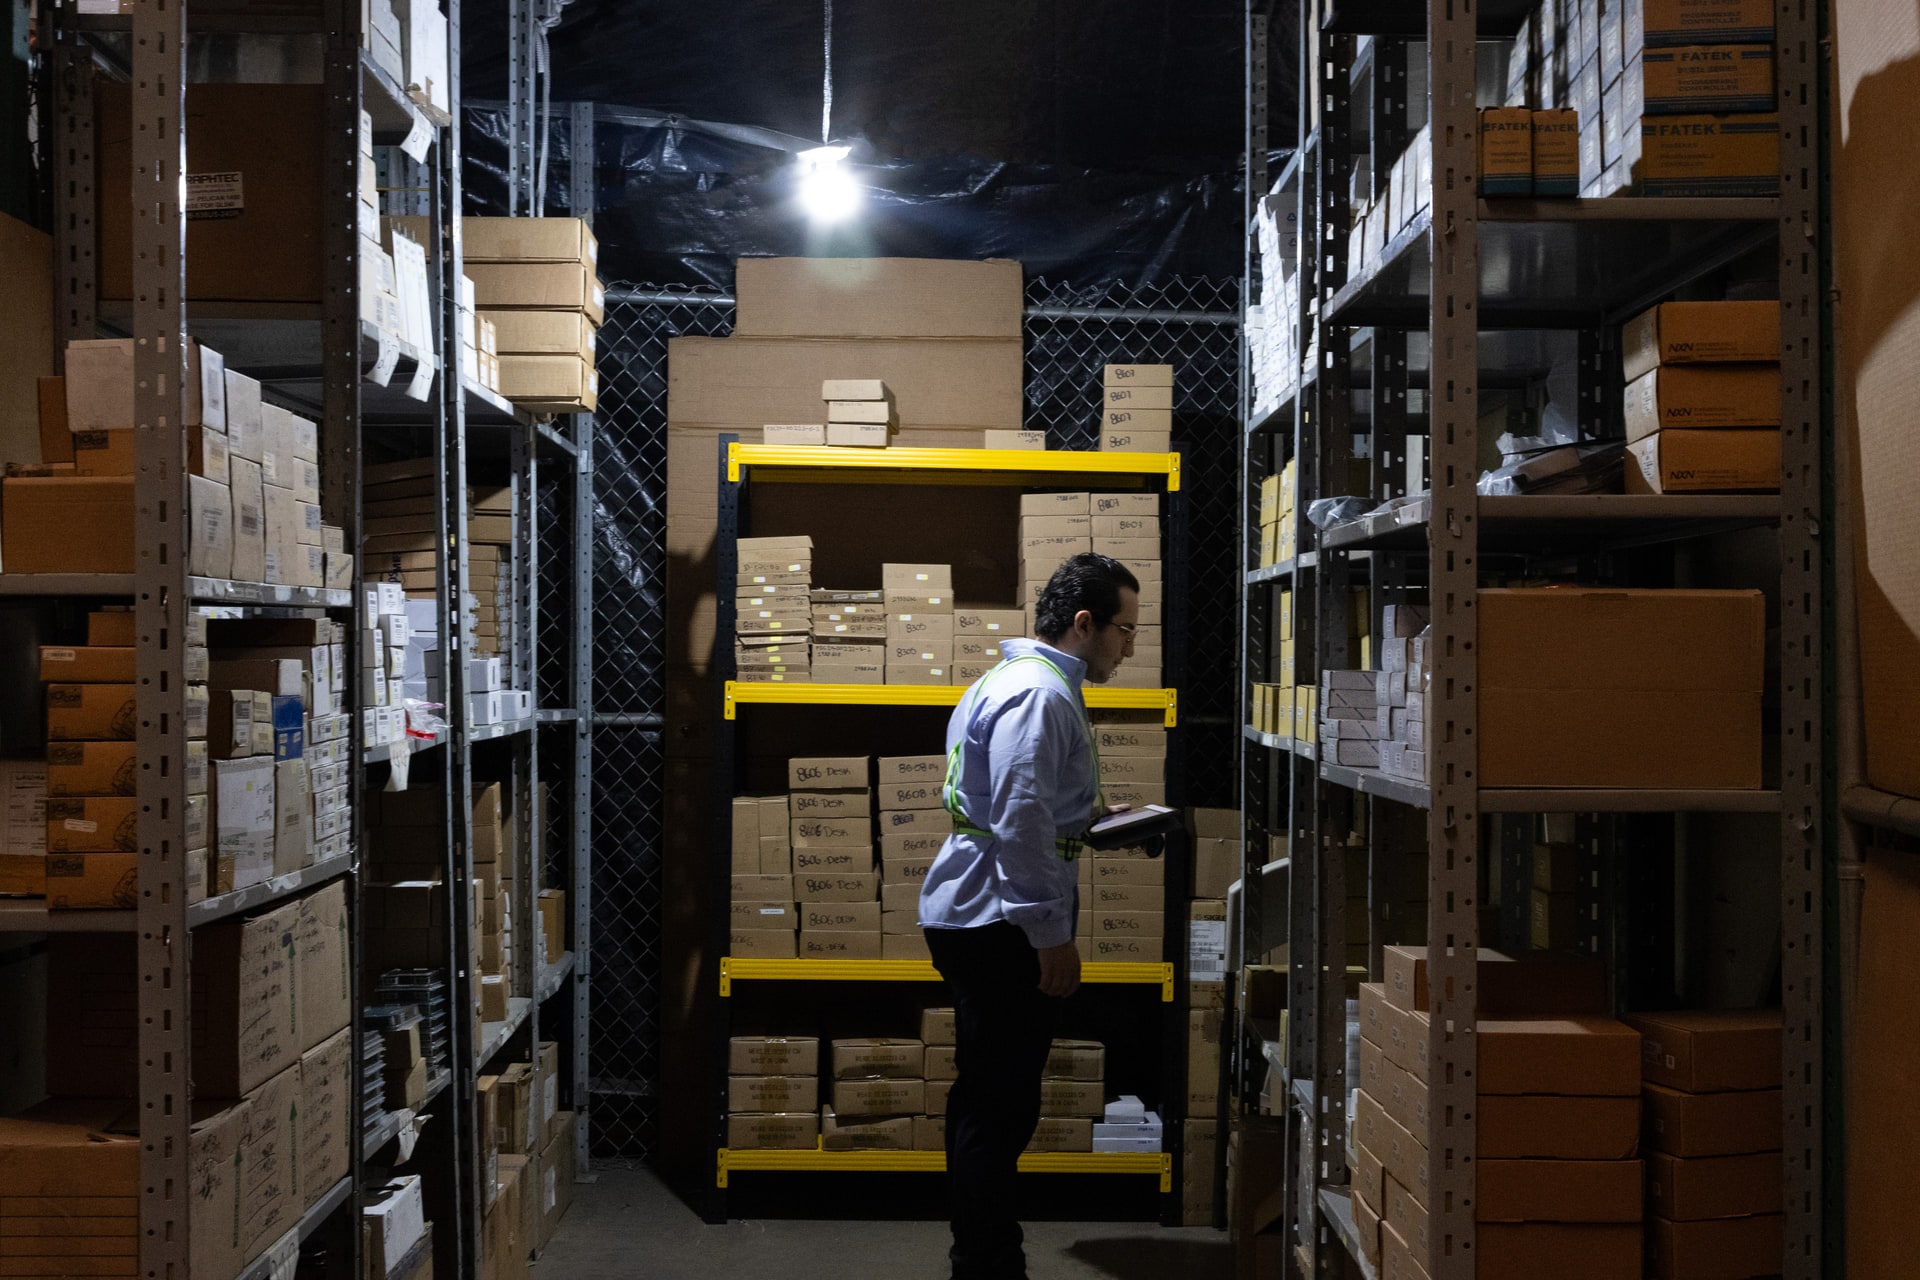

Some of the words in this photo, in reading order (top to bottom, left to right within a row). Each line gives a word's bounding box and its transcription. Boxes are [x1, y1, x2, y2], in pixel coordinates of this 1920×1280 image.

[1681, 51, 1732, 61] FATEK
[1491, 122, 1529, 131] FATEK
[1536, 123, 1576, 132] FATEK
[1660, 124, 1715, 136] FATEK
[187, 173, 239, 185] RAPHTEC
[1668, 343, 1693, 353] NXN
[1110, 390, 1131, 401] 8607
[1666, 408, 1692, 417] NXN
[1110, 412, 1131, 425] 8607
[1109, 436, 1131, 447] 8607
[1669, 470, 1695, 480] NXN
